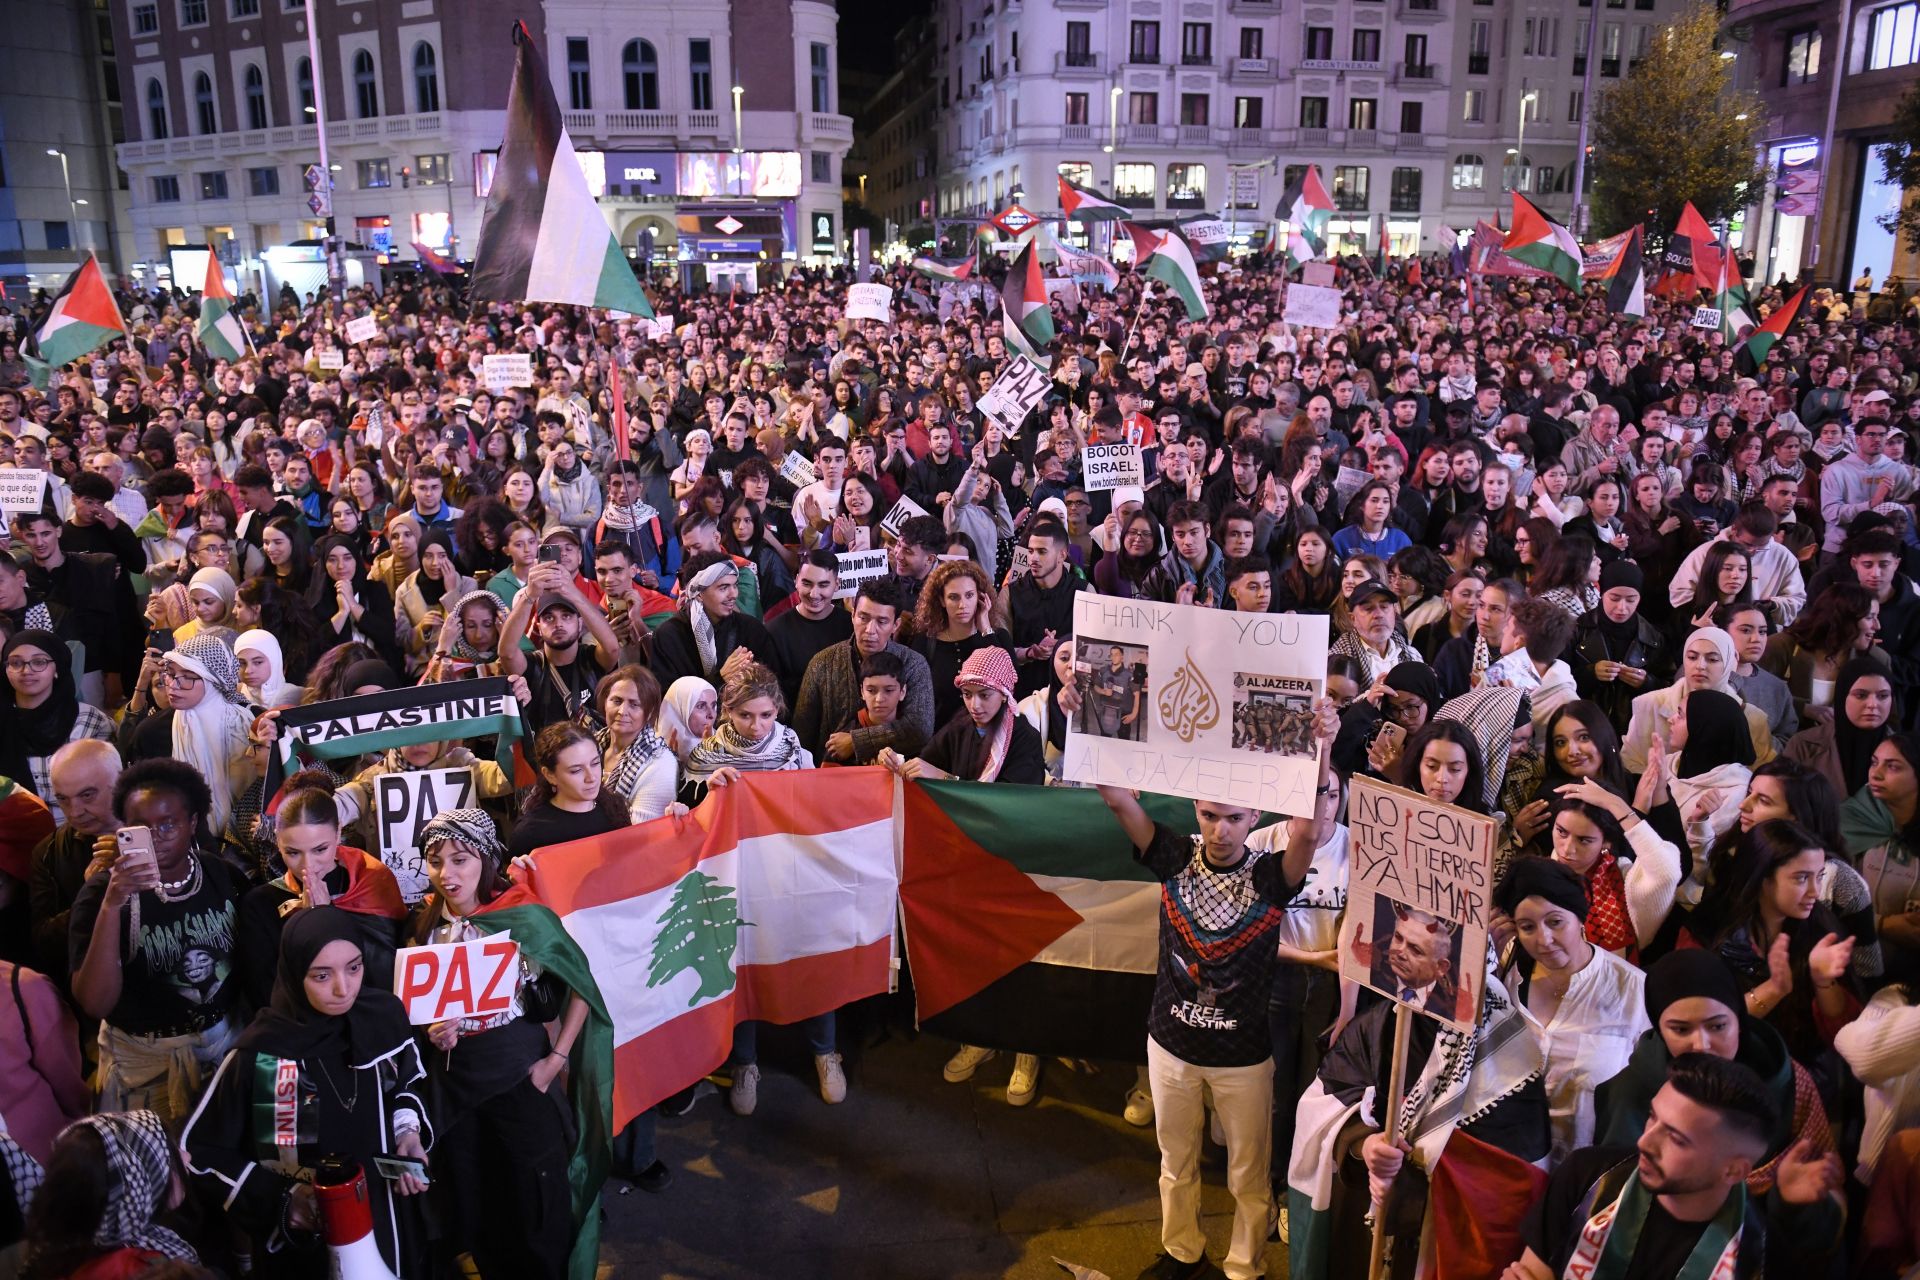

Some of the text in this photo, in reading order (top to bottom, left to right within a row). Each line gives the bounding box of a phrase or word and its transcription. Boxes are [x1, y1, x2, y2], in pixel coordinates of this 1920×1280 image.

[1241, 61, 1266, 69] HOSTAL
[1316, 61, 1379, 70] CONTINENTAL
[1005, 216, 1027, 225] Metro
[1184, 224, 1225, 238] PALESTINE
[1696, 310, 1720, 326] PEACE!
[997, 357, 1051, 413] PAZ
[1087, 446, 1136, 459] BOICOT
[1088, 461, 1138, 474] ISRAEL:
[7, 485, 20, 493] que
[1090, 476, 1139, 489] www.boicotisrael.net
[854, 558, 864, 571] por
[839, 578, 857, 590] ismo
[1077, 599, 1300, 646] THANK YOU
[1247, 677, 1314, 692] AL JAZEERA
[299, 696, 504, 745] PALASTINE
[1075, 746, 1314, 812] AL JAZEERA
[1359, 791, 1474, 852] NO SON
[1352, 820, 1485, 887] TUS TIERRAS
[1360, 848, 1484, 929] YA HMAR
[402, 942, 516, 1018] PAZ
[1170, 1004, 1237, 1030] PALESTINE
[1182, 1000, 1224, 1020] FREE
[277, 1060, 298, 1147] ESTINE
